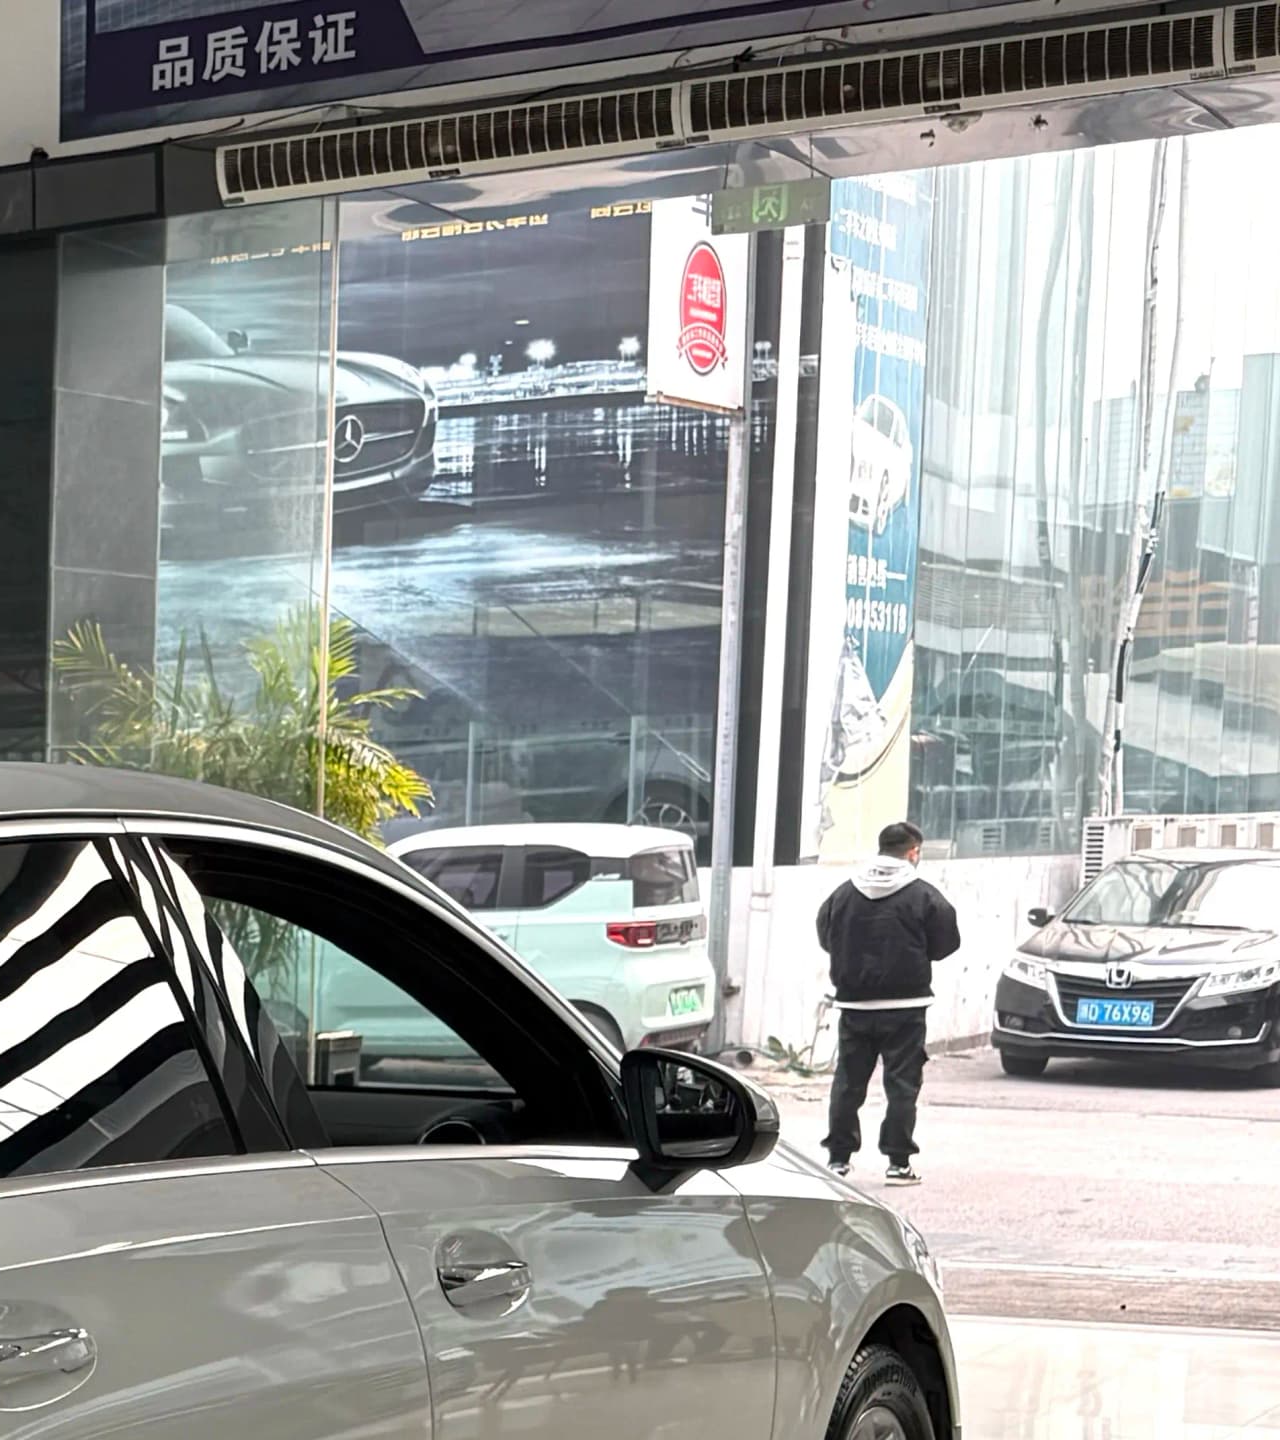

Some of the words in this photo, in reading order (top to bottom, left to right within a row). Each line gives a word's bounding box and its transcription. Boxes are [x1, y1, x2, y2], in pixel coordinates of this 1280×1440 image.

[152, 11, 357, 91] 品质保证
[1103, 1003, 1151, 1024] 76X96
